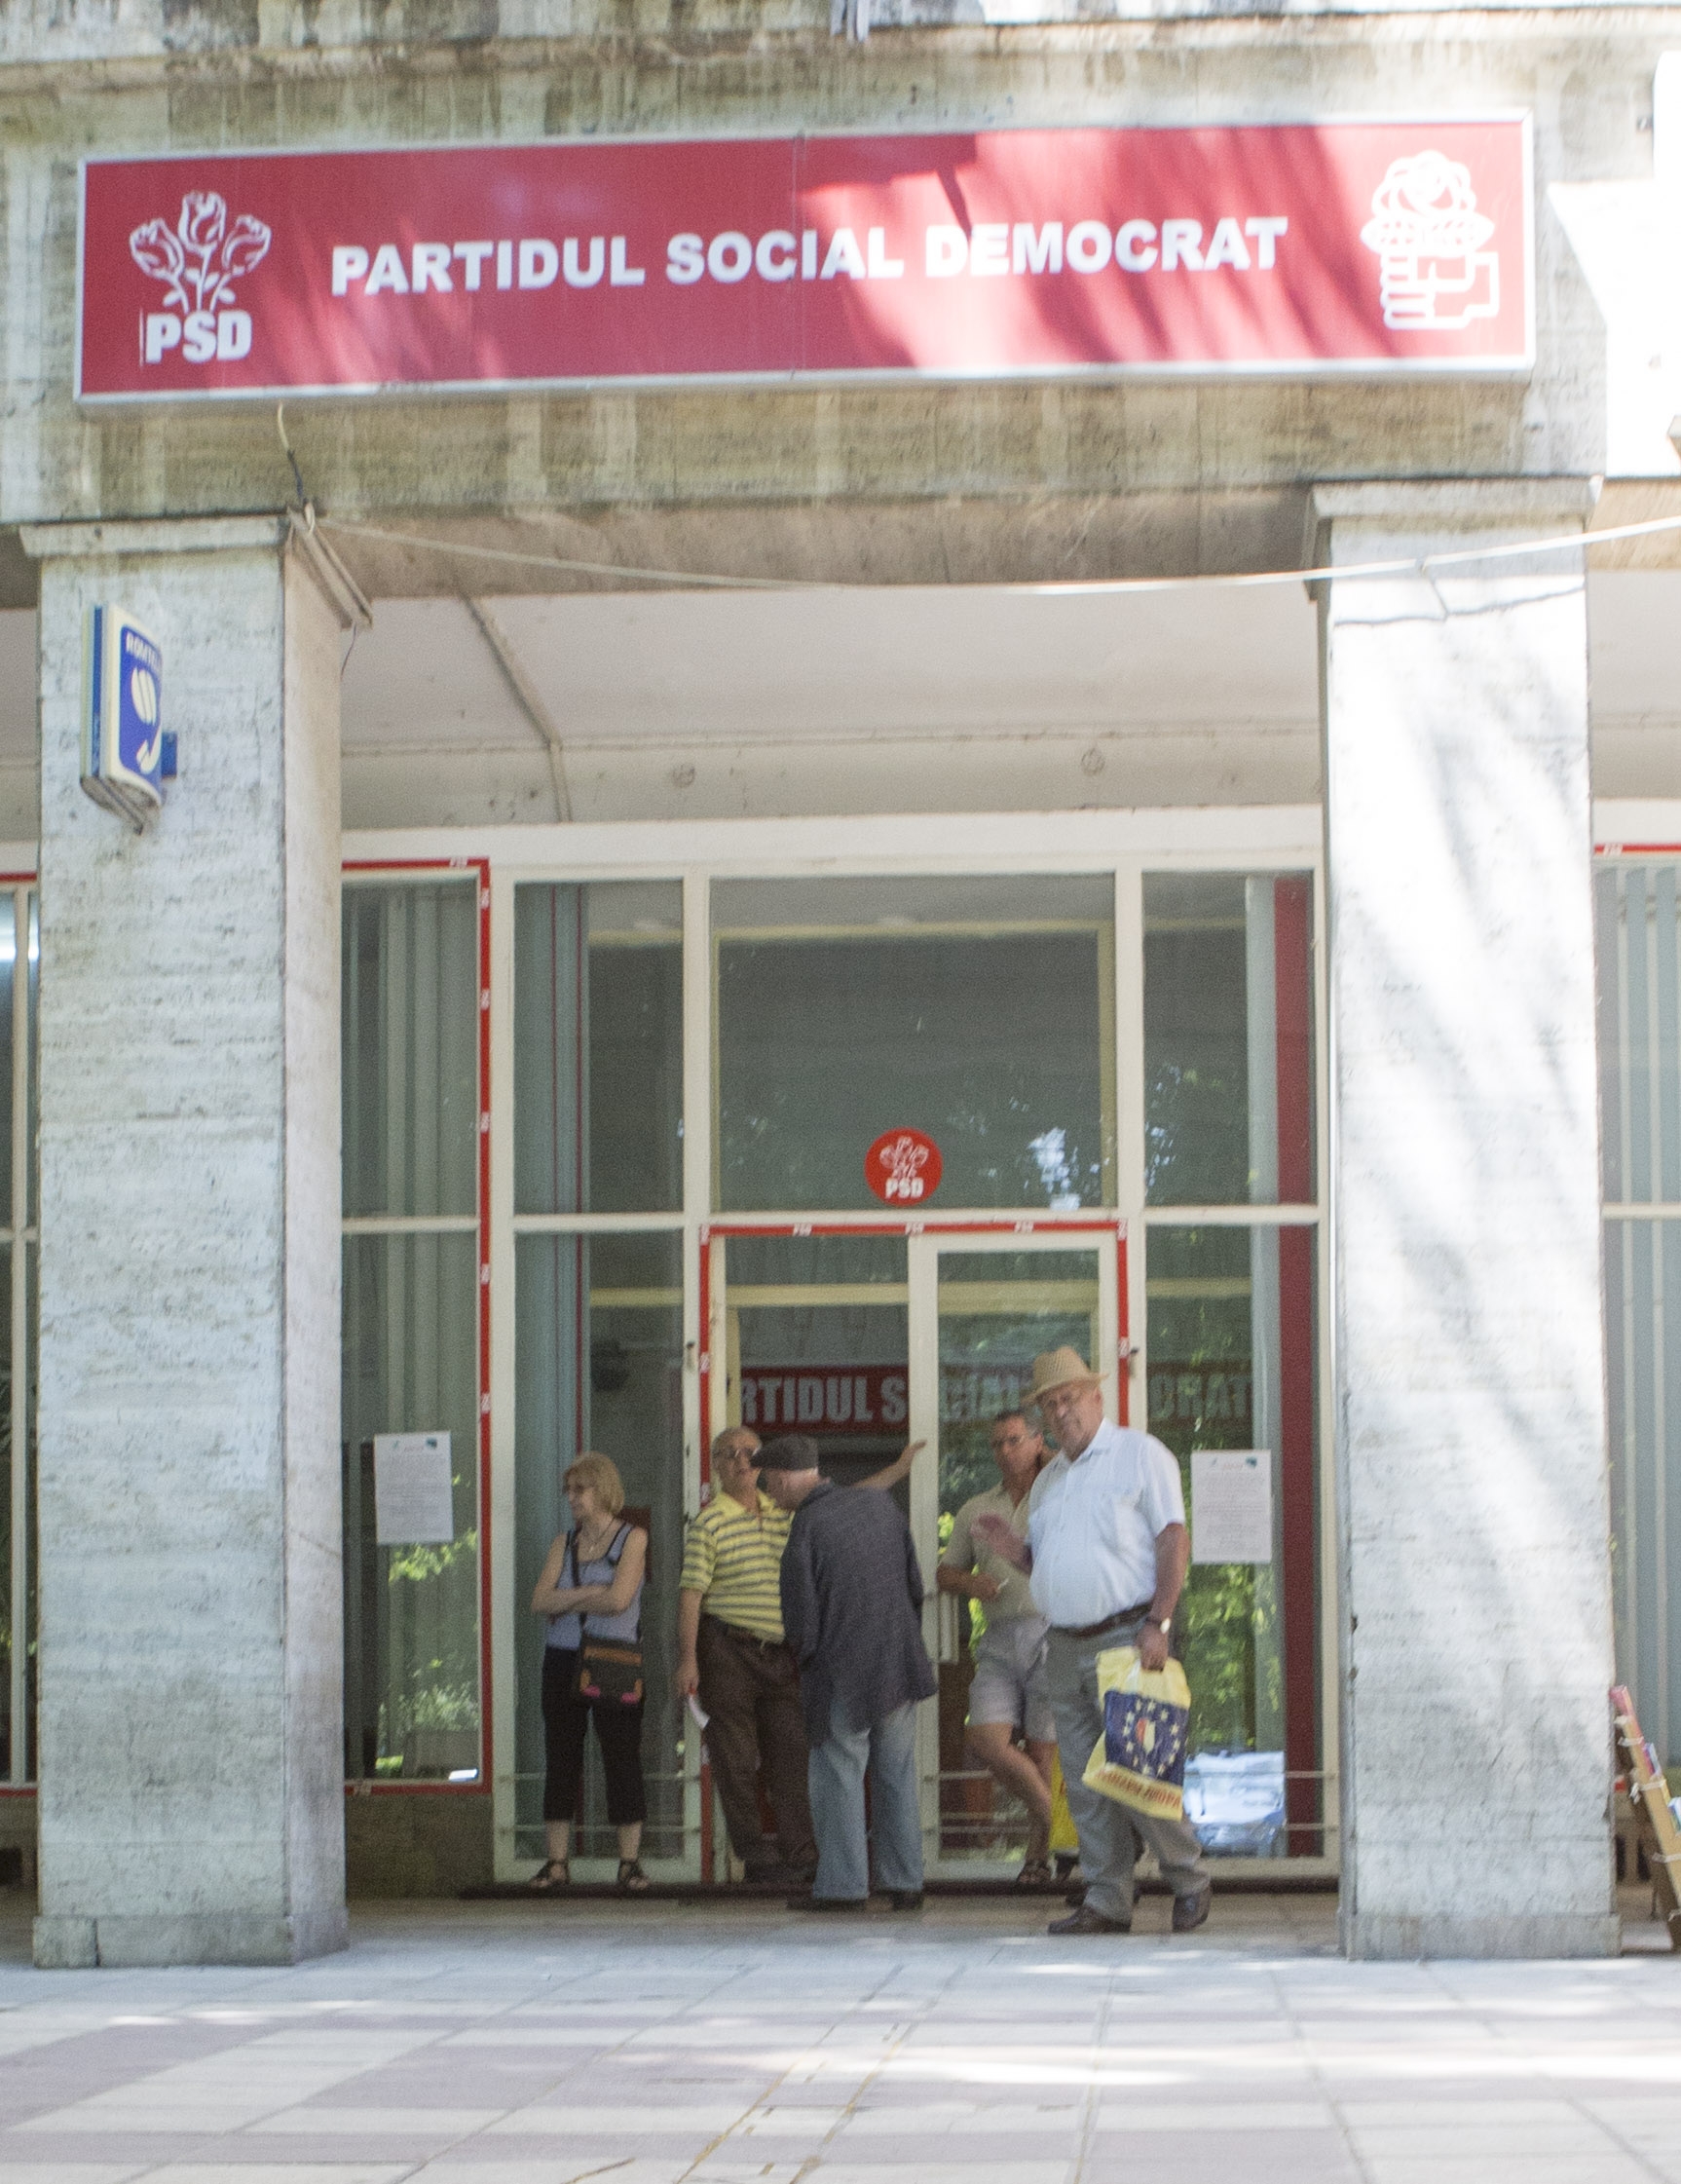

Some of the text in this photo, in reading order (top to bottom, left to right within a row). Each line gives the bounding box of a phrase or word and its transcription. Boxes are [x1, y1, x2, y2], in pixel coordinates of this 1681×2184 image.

[331, 215, 1289, 296] PARTIDUL SOCIAL DEMOCRAT
[145, 309, 253, 364] PSD
[884, 1176, 924, 1199] PSD
[740, 1374, 874, 1424] RTIDUL
